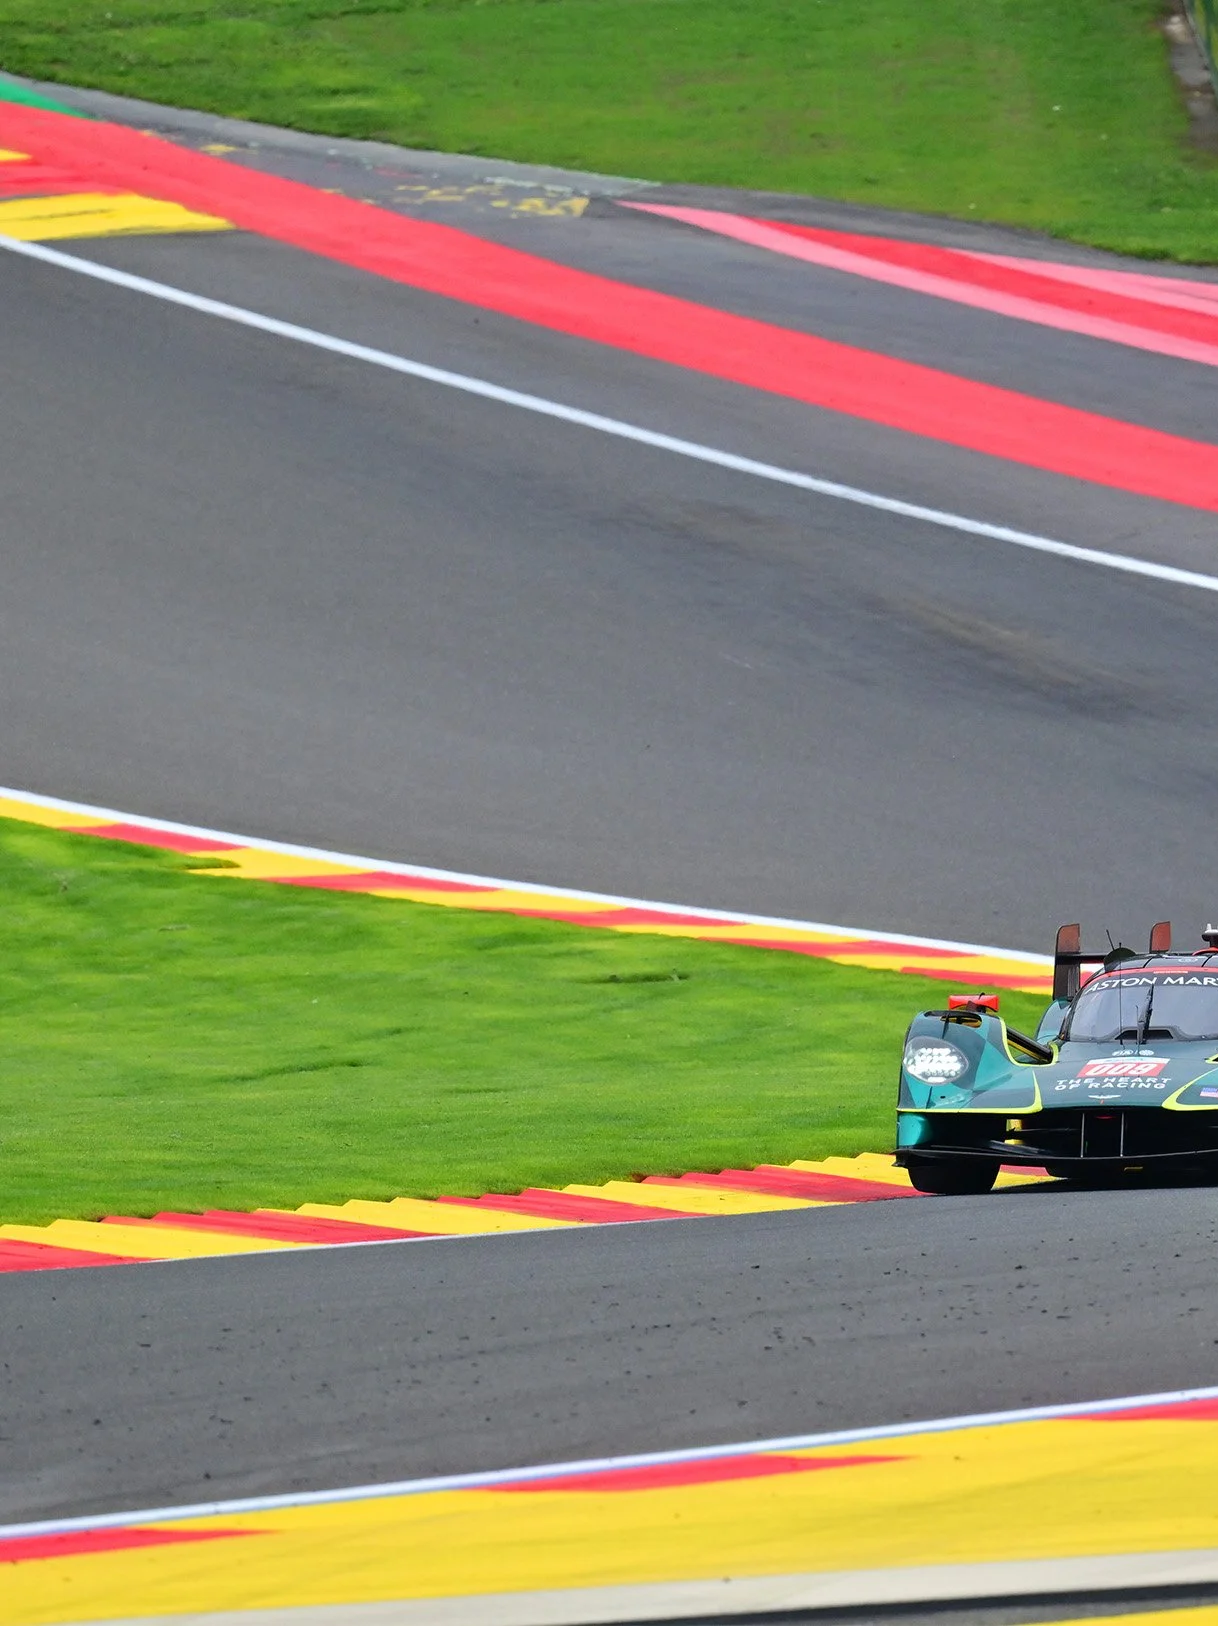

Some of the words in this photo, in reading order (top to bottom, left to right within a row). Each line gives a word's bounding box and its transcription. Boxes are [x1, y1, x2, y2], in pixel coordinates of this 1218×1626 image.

[1083, 976, 1157, 993] ASTON
[1057, 1077, 1095, 1085] THE
[1103, 1076, 1171, 1084] HEART
[1054, 1083, 1081, 1091] OF
[1088, 1082, 1166, 1090] RACING
